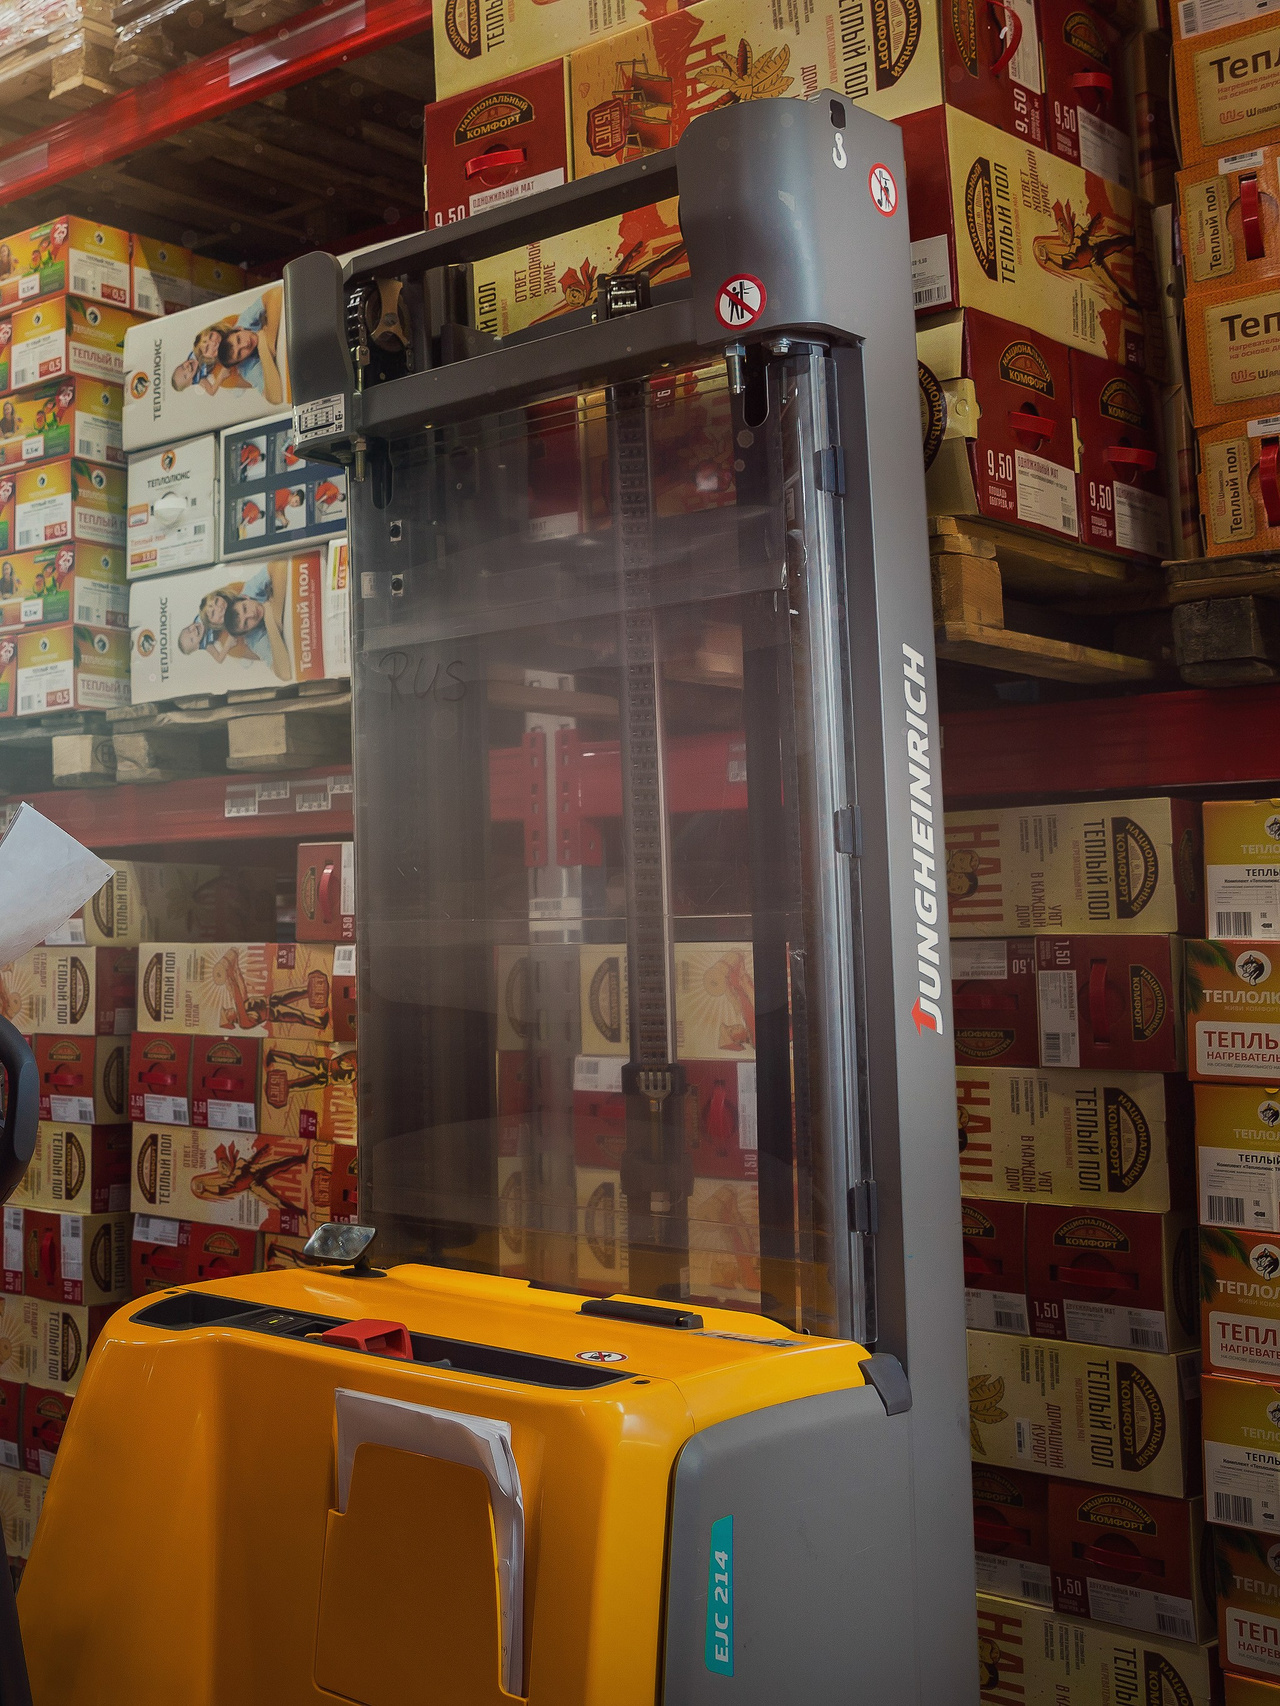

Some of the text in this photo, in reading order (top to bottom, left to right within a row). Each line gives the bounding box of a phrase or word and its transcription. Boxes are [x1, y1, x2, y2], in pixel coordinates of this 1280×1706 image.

[844, 61, 869, 100] ПОЛ
[458, 94, 529, 132] НАЦИОНАЛЬНЫЙ
[466, 114, 522, 139] КОМФОРТ
[595, 109, 613, 150] 15 ЛЕТ
[1013, 88, 1029, 135] 9,50
[1054, 100, 1077, 133] 9,50
[520, 180, 535, 194] МАТ
[1020, 169, 1032, 209] ОТВЕТ
[1039, 182, 1052, 218] ЗИМЕ
[966, 162, 989, 271] НАЦИОНАЛЬНЫЙ
[982, 178, 995, 261] КОМФОРТ
[993, 162, 1016, 284] ТЕПЛЫЙ ПОЛ
[1205, 185, 1223, 271] Теплый пол
[478, 281, 497, 314] ПОЛ
[515, 270, 527, 303] ОТВЕТ
[543, 261, 556, 295] ЗИМЕ
[152, 338, 163, 422] ТЕПЛОЛЮКС
[1001, 341, 1051, 382] НАЦИОНАЛЬНЫЙ
[1008, 369, 1048, 393] КОМФОРТ
[147, 470, 191, 489] ТЕПЛОЛЮКС
[987, 449, 1013, 482] 9,50
[1089, 481, 1112, 512] 9,50
[1225, 446, 1243, 534] Теплый пол
[158, 597, 169, 683] ТЕПЛОЛЮКС
[298, 562, 313, 672] Теплый пол
[901, 642, 944, 1036] JUNGHEINRICH
[1083, 818, 1111, 921] ТЕПЛЫЙ ПОЛ
[1115, 833, 1129, 903] КОМФОРТ
[1124, 822, 1159, 912] НАЦИОНАЛЬНЫЙ
[116, 870, 129, 938] ТЕПЛЫЙ ПОЛ
[1014, 904, 1031, 929] ДОМ
[1030, 884, 1048, 929] КАЖДЫЙ
[1046, 903, 1063, 928] УЮТ
[1053, 940, 1070, 966] 1,50
[57, 956, 69, 1025] ТЕПЛЫЙ ПОЛ
[163, 951, 176, 1023] ТЕПЛЫЙ ПОЛ
[1133, 976, 1142, 1030] КОМФОРТ
[1139, 968, 1166, 1036] НАЦИОНАЛЬНЫЙ
[1074, 1087, 1104, 1192] ТЕПЛЫЙ ПОЛ
[1107, 1103, 1122, 1176] КОМФОРТ
[1117, 1094, 1152, 1188] НАЦИОНАЛЬНЫЙ
[52, 1131, 63, 1200] ТЕПЛЫЙ ПОЛ
[158, 1133, 172, 1205] ТЕПЛЫЙ ПОЛ
[1004, 1167, 1020, 1192] ДОМ
[1021, 1143, 1037, 1193] КАЖДЫЙ
[1038, 1170, 1054, 1195] УЮТ
[1057, 1217, 1126, 1242] НАЦИОНАЛЬНЫЙ
[1065, 1237, 1118, 1249] КОМФОРТ
[1033, 1301, 1059, 1319] 1,50
[47, 1311, 60, 1381] ТЕПЛЫЙ ПОЛ
[1045, 1402, 1066, 1470] ДОМАШНИЙ
[1086, 1360, 1116, 1469] ТЕПЛЫЙ ПОЛ
[1120, 1379, 1136, 1456] КОМФОРТ
[1130, 1370, 1166, 1468] НАЦИОНАЛЬНЫЙ
[1031, 1422, 1048, 1467] КУРОРТ
[1081, 1493, 1152, 1525] НАЦИОНАЛЬНЫЙ
[1089, 1514, 1146, 1532] КОМФОРТ
[714, 1550, 730, 1663] EJC 214
[1055, 1575, 1082, 1597] 1,50
